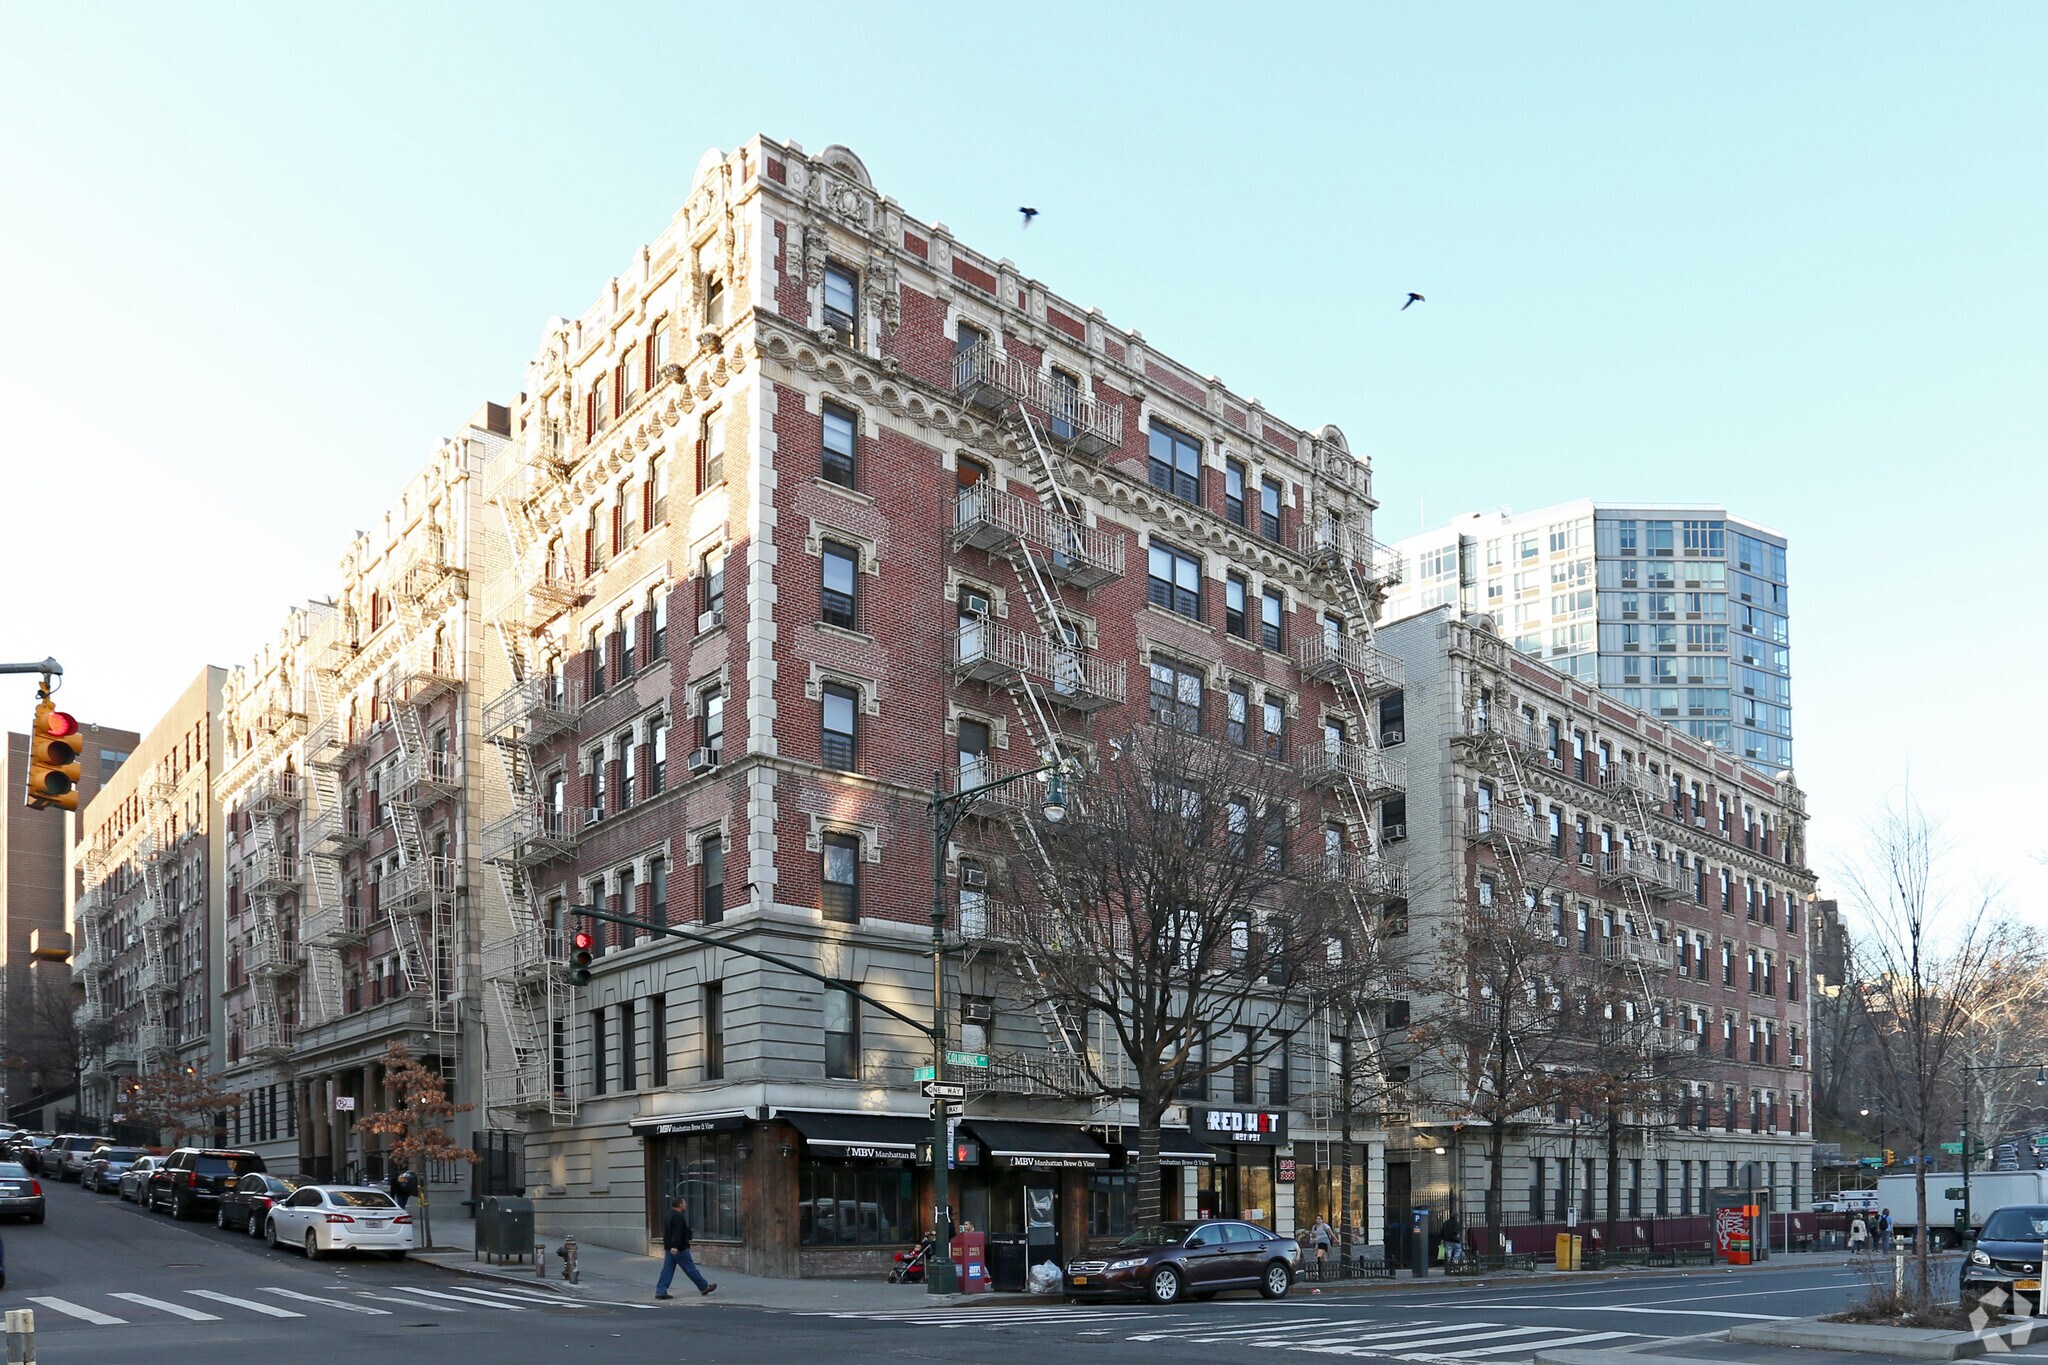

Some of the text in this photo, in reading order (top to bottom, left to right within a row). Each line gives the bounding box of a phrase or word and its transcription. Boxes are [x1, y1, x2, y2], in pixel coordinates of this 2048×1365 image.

[947, 1052, 978, 1066] COLUMBUS
[928, 1086, 961, 1095] ONE WAY
[1206, 1111, 1279, 1132] RED HOT
[660, 1124, 672, 1134] MBV
[1232, 1133, 1261, 1142] HOT POT
[851, 1147, 875, 1157] MBV
[875, 1150, 909, 1159] Manhattan
[1015, 1157, 1034, 1165] MBV
[1034, 1159, 1063, 1167] Manhattan
